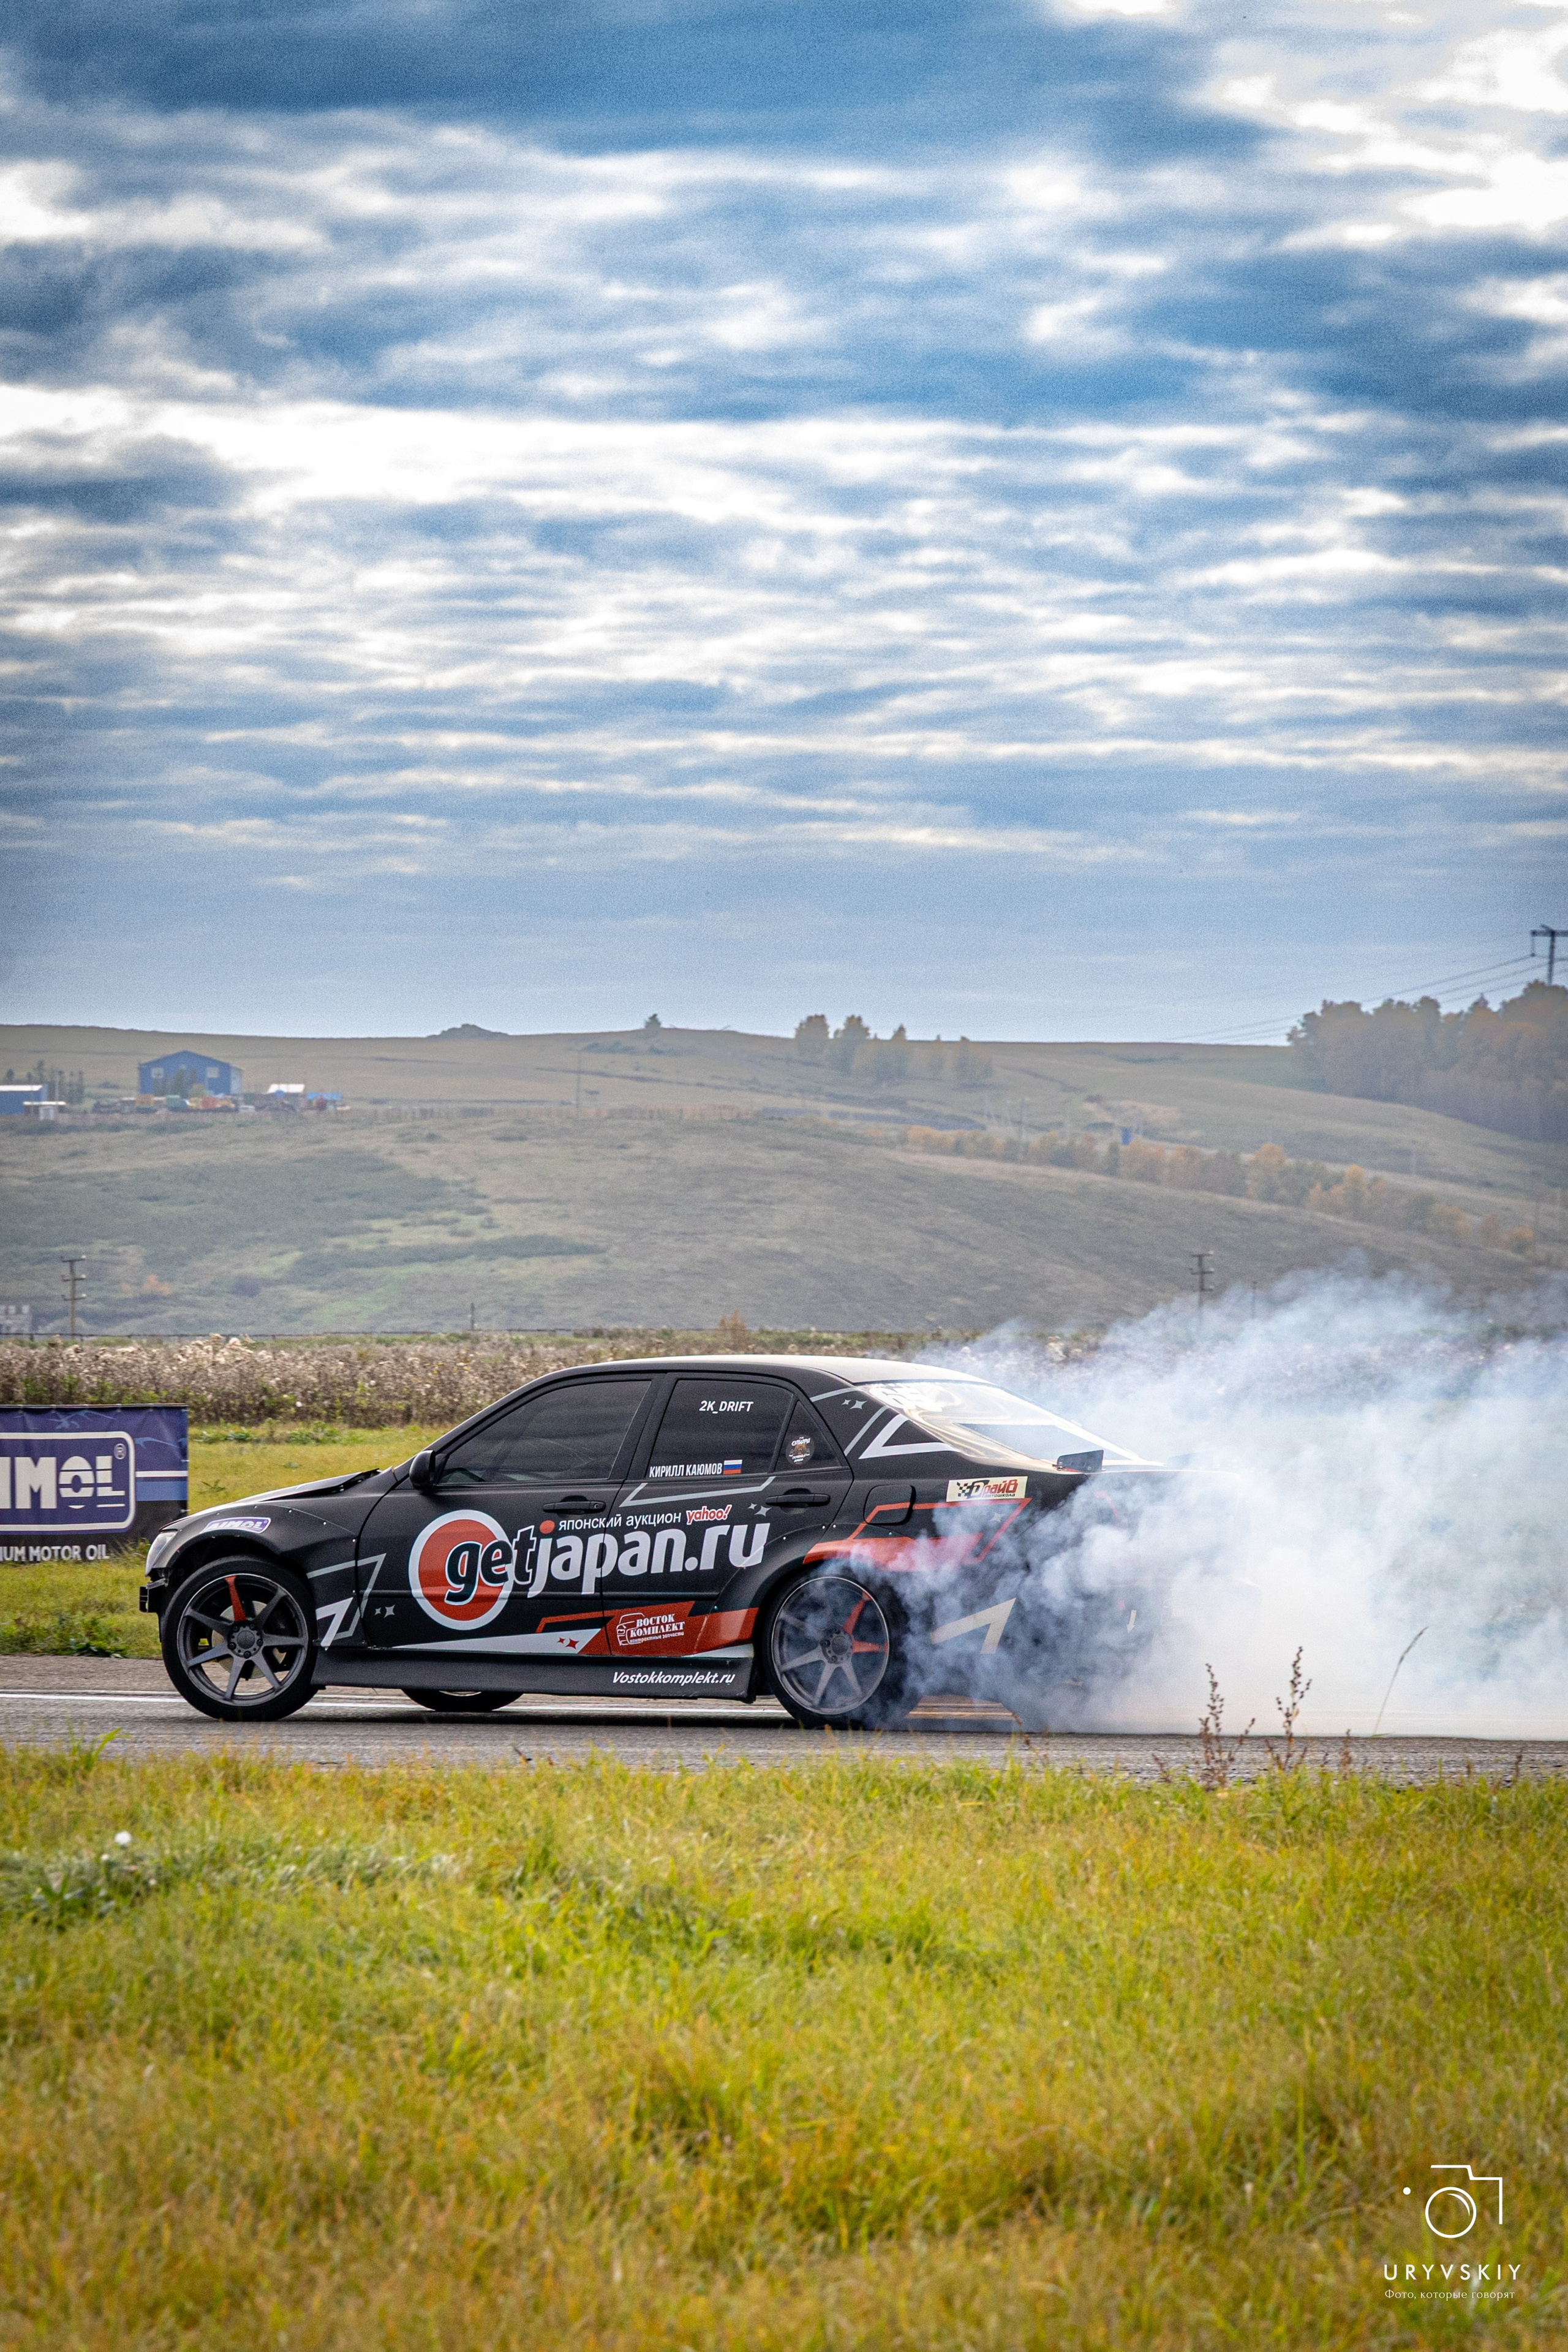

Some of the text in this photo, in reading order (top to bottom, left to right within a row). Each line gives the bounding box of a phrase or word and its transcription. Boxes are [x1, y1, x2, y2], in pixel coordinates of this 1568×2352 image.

[699, 1401, 754, 1414] 2K_DRIFT
[649, 1462, 723, 1478] КИРИЛЛ КАЮМОВ
[625, 1512, 682, 1529] аукцион
[686, 1504, 732, 1524] yahoo!
[29, 1545, 82, 1562] MOTOR
[85, 1544, 110, 1560] OIL
[636, 1613, 676, 1627] ВОСТОК
[630, 1621, 685, 1638] КОМПЛЕКТ
[612, 1671, 736, 1686] Vostokkomplekt.ru
